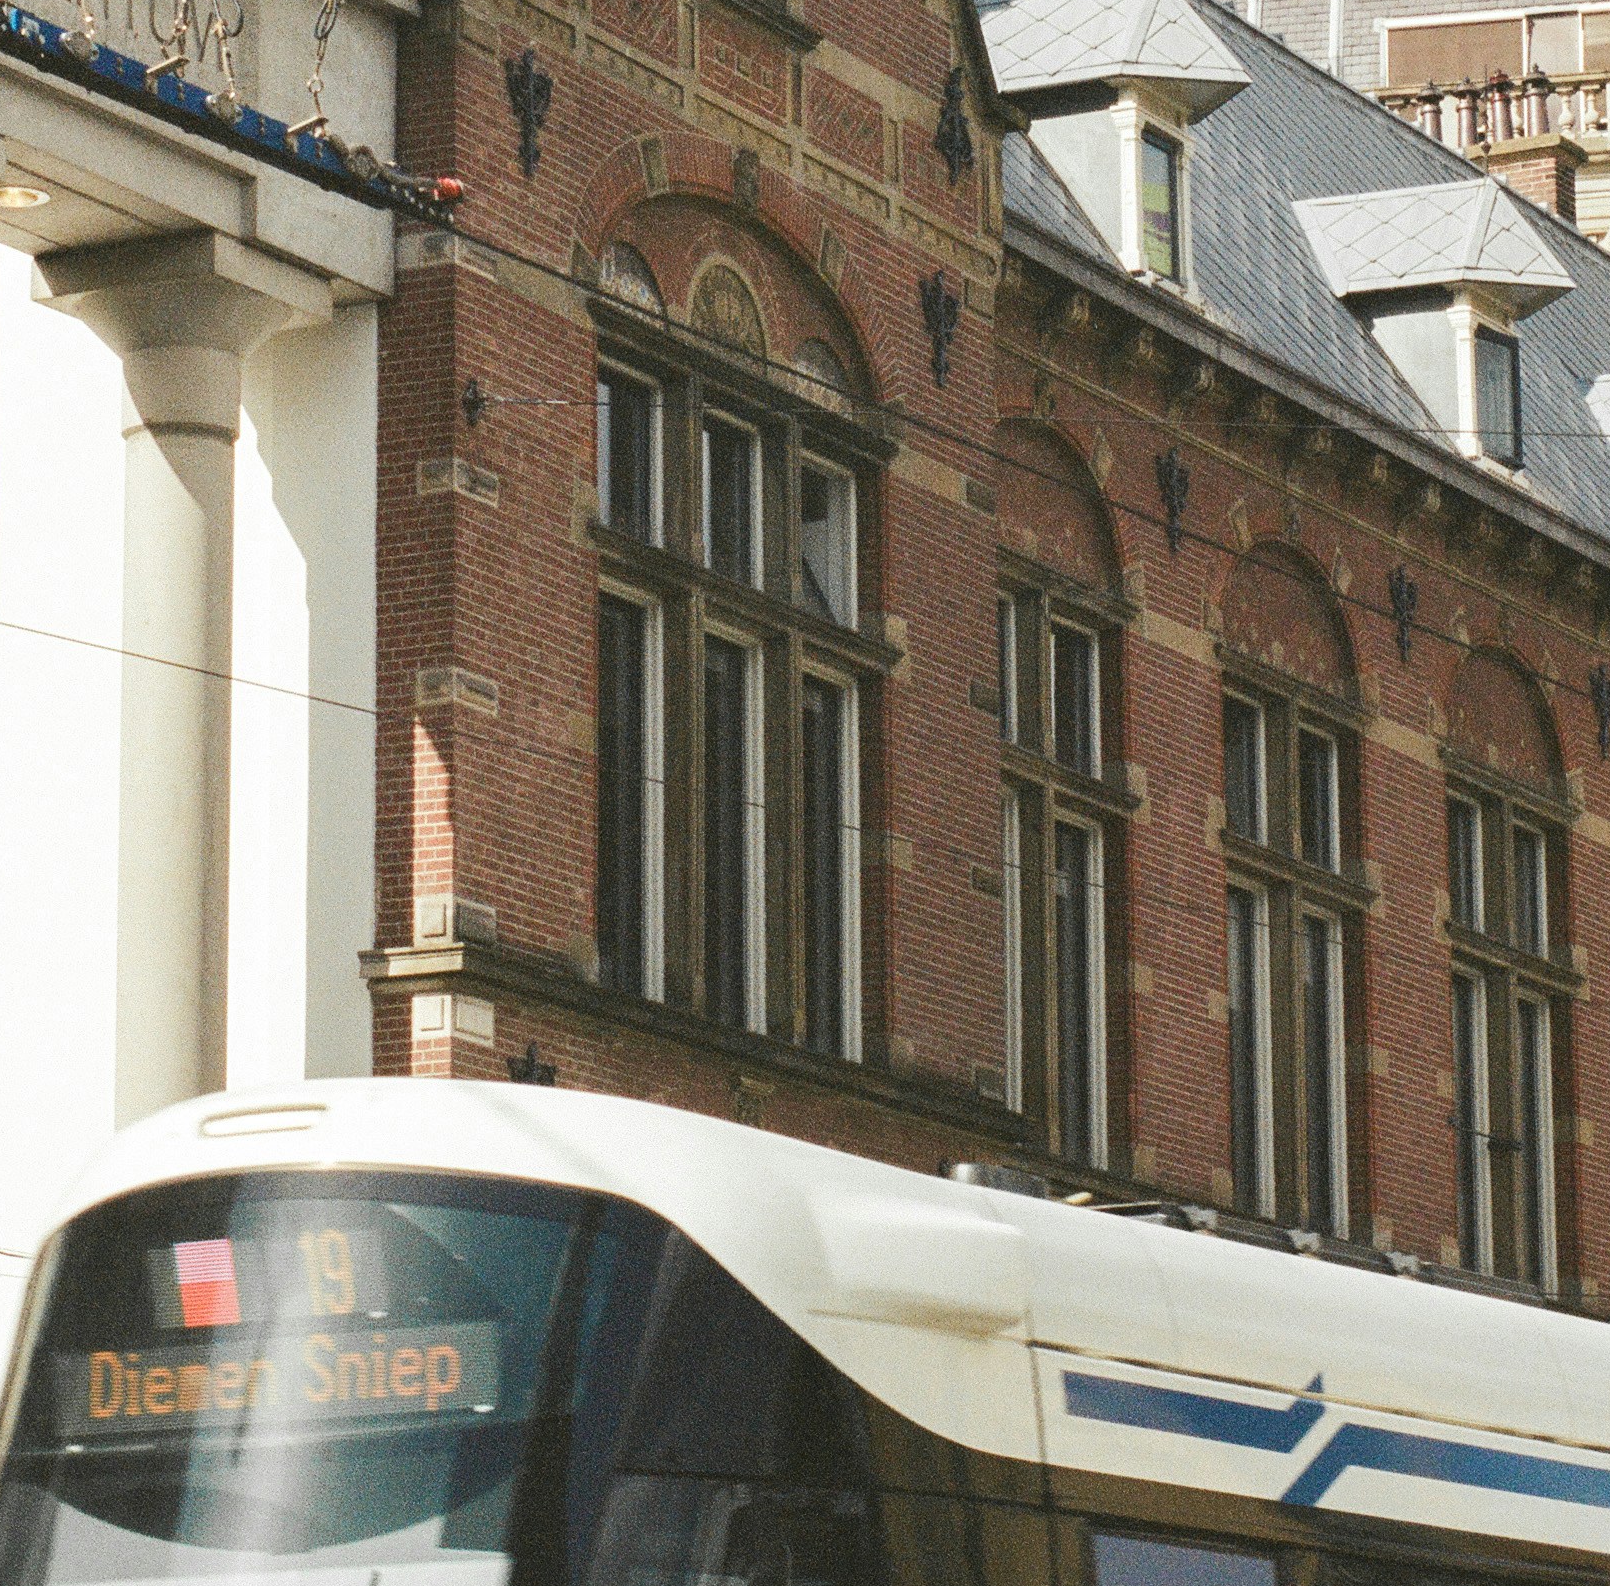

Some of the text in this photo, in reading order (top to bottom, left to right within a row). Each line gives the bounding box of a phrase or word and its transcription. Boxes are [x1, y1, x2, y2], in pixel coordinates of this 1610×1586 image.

[297, 1229, 357, 1316] 19
[89, 1332, 462, 1419] Diemen Sniep
